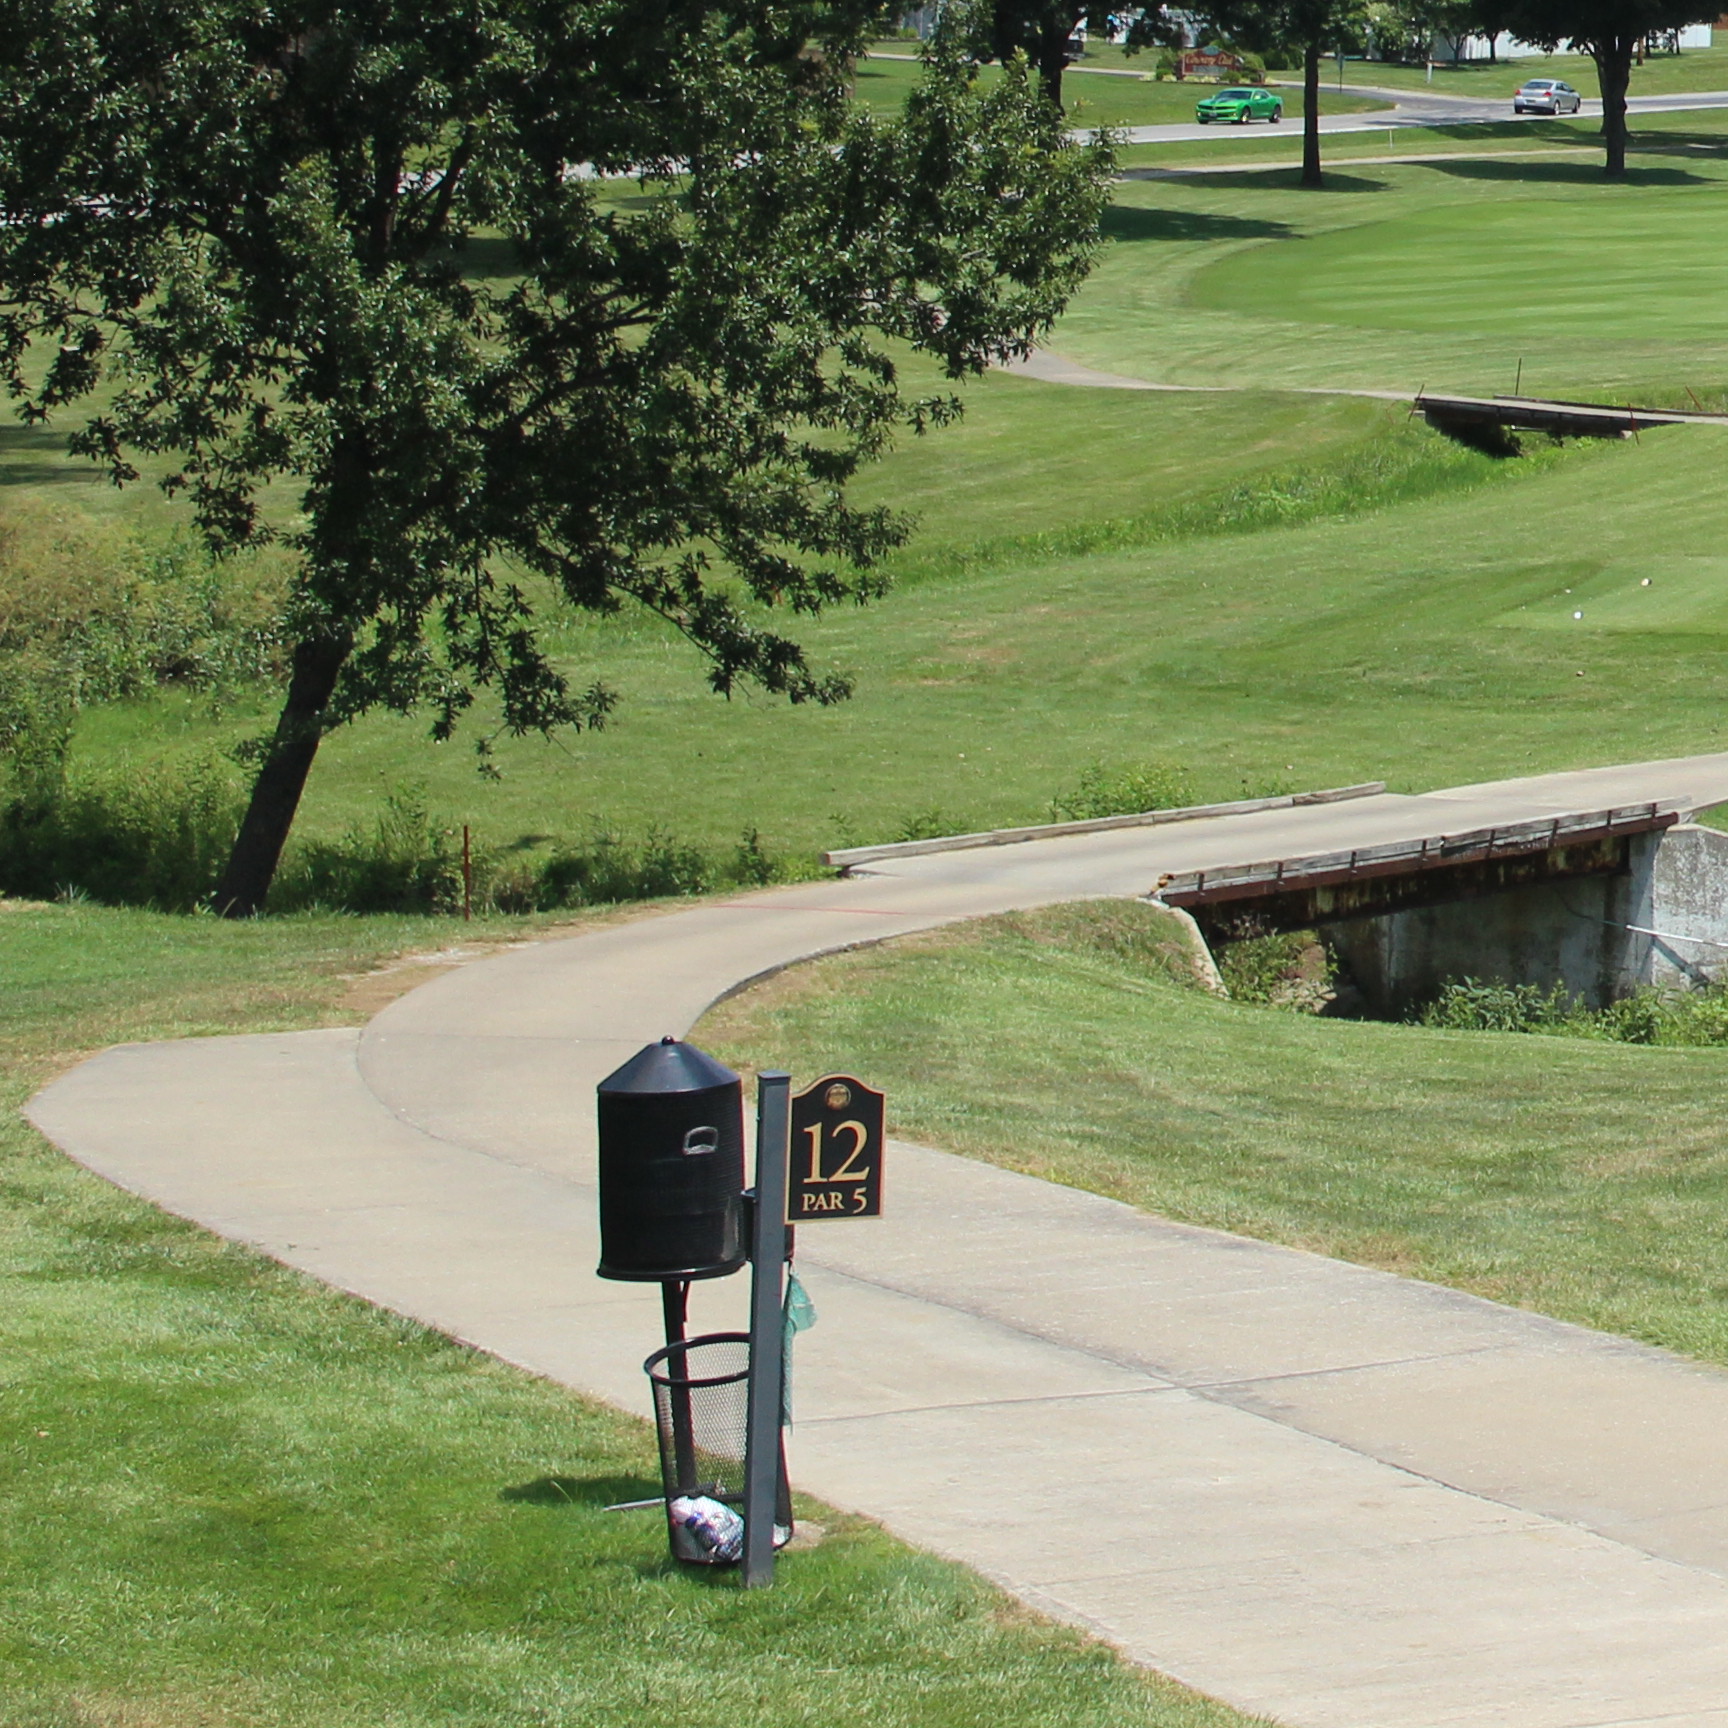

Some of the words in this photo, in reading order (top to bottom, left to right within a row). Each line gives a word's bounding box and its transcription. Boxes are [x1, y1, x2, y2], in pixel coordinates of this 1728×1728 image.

[803, 1120, 870, 1183] 12
[802, 1191, 845, 1211] PAR
[852, 1186, 868, 1214] 5
